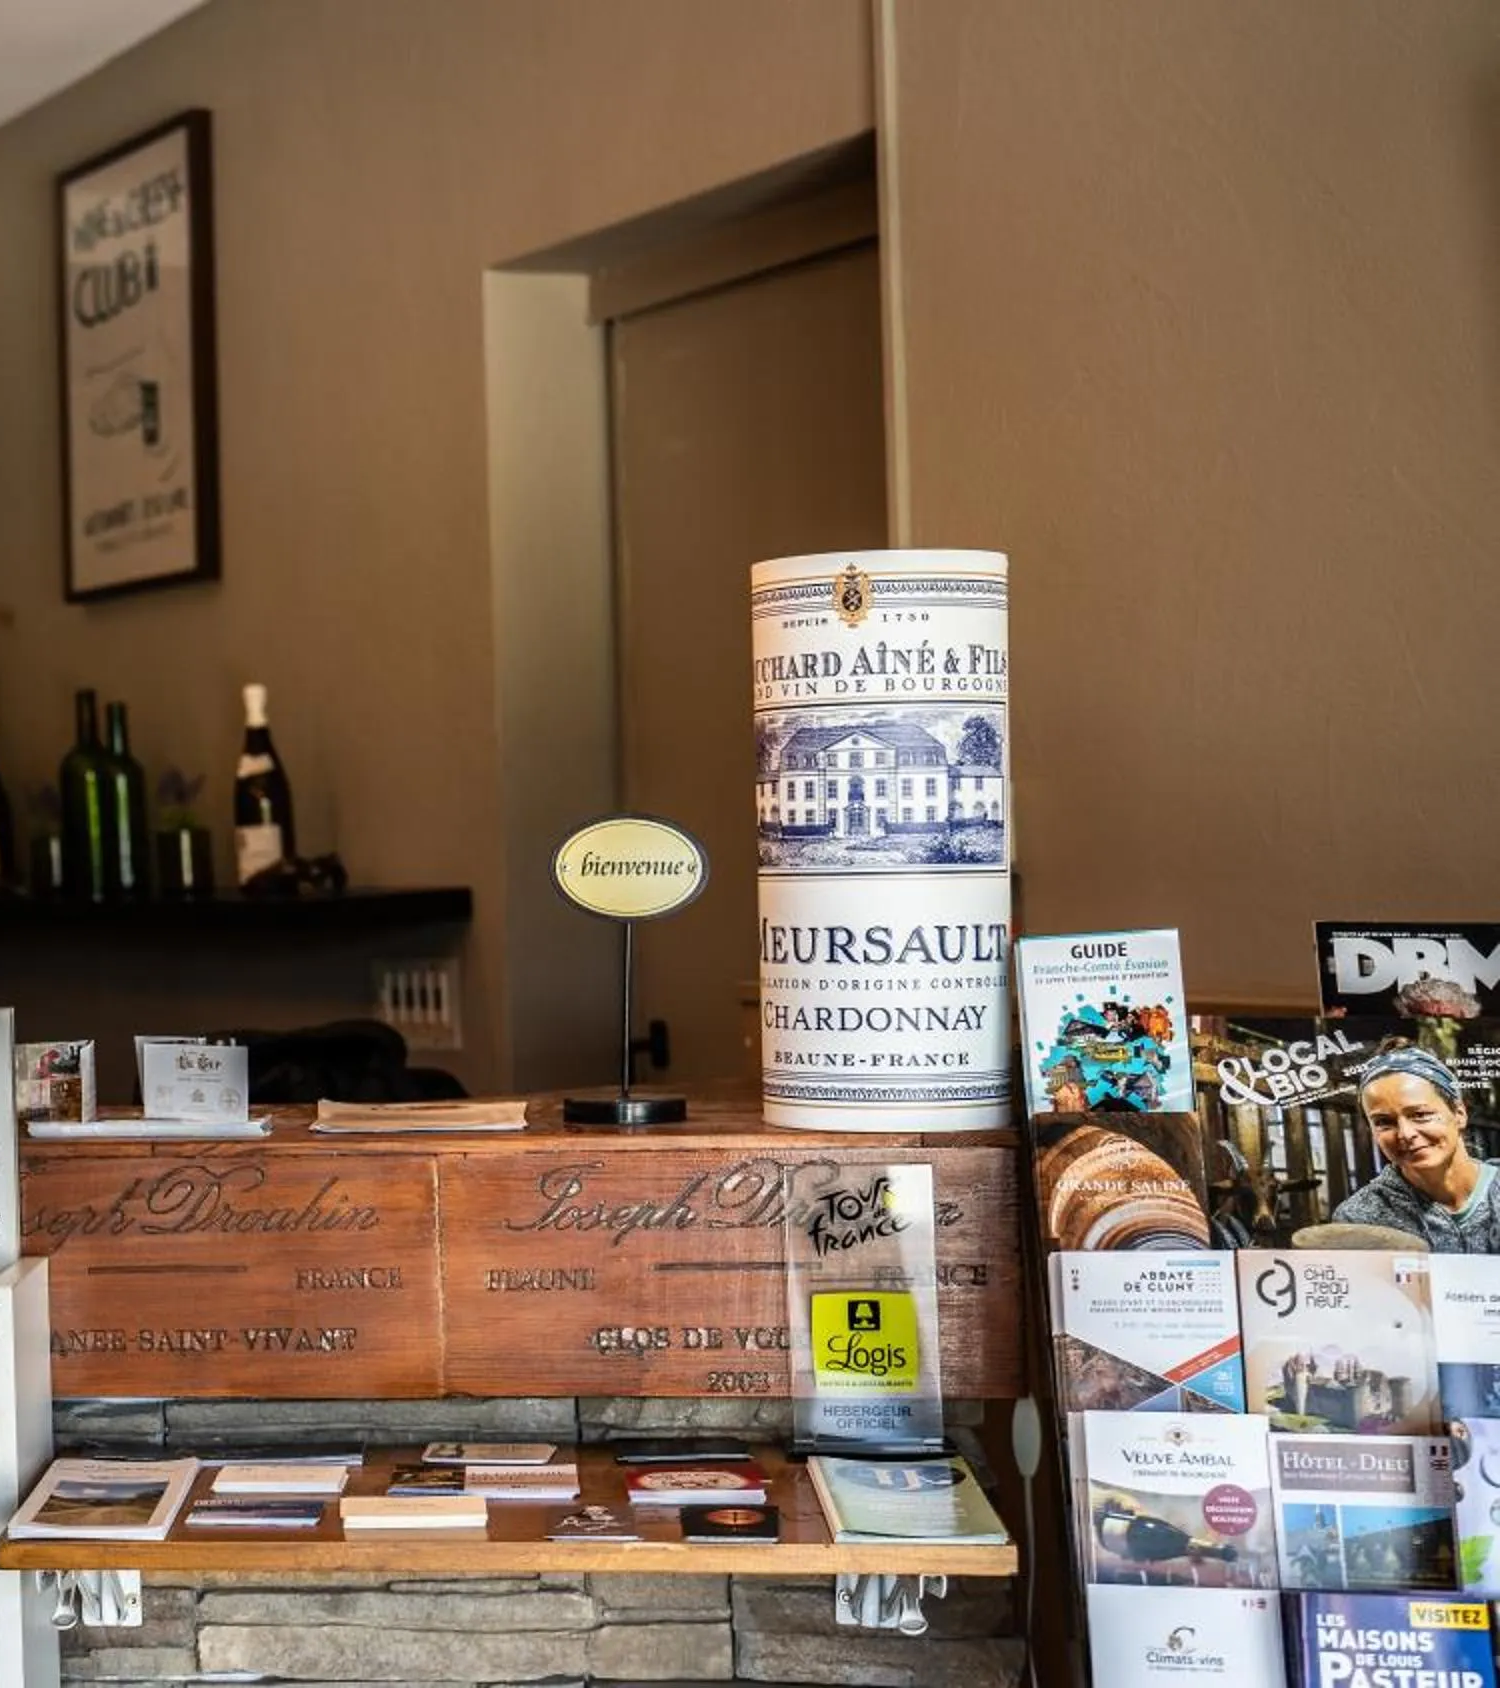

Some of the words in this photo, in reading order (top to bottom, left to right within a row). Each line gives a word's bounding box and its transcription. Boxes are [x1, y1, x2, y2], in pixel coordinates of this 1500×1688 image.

[849, 640, 936, 677] AÎNÉ
[943, 648, 960, 674] &
[781, 681, 818, 696] VIN
[835, 679, 868, 693] DE
[885, 677, 1007, 693] BOURGOGN
[581, 851, 685, 877] bienvenue
[1070, 941, 1128, 960] GUIDE
[764, 1000, 987, 1031] CHARDONNAY
[1242, 1028, 1364, 1079] LOCAL
[1265, 1064, 1329, 1100] BIO
[21, 1178, 137, 1252] seph
[503, 1161, 708, 1247] Joseph
[294, 1266, 404, 1291] FRANCE
[1124, 1281, 1142, 1293] DE
[1147, 1281, 1195, 1293] CLUNY
[1139, 1269, 1194, 1281] ABBAYE
[682, 1327, 723, 1349] DE
[825, 1331, 907, 1377] Logis
[835, 1417, 897, 1430] OFFICIEL
[1122, 1448, 1175, 1465] VEUVE
[1179, 1450, 1237, 1467] AMBAL
[1315, 1612, 1347, 1628] LES
[1414, 1605, 1482, 1625] VISITEZ
[1316, 1628, 1436, 1652] MAISONS
[1318, 1651, 1484, 1688] PASTEUR
[1355, 1652, 1376, 1667] DE
[1379, 1653, 1424, 1668] LOUIS
